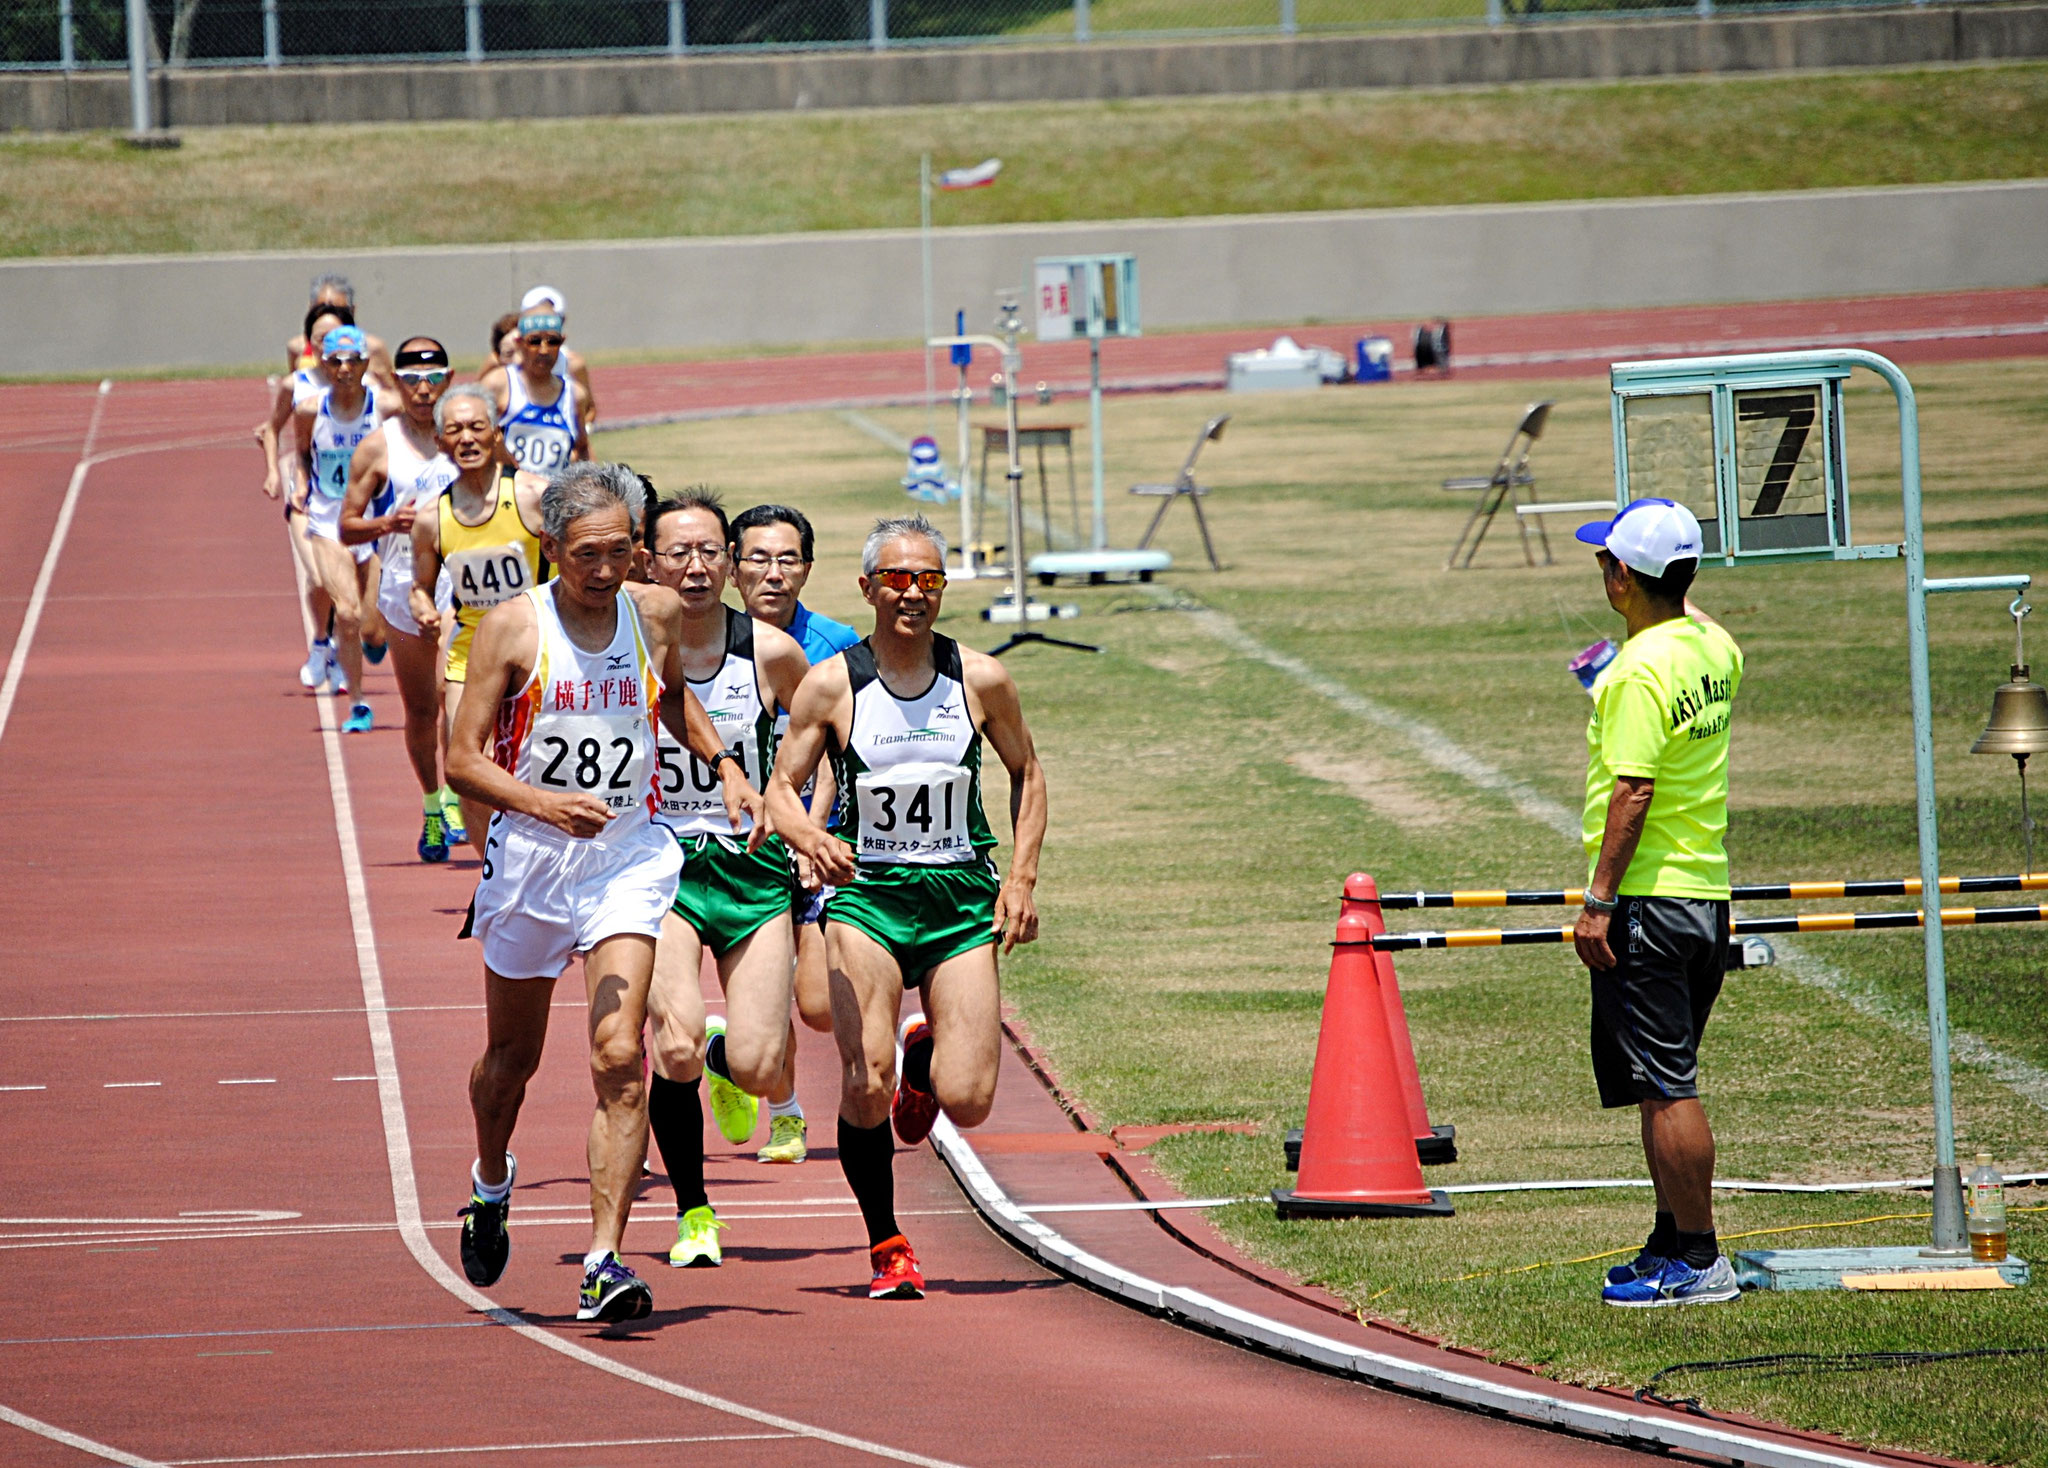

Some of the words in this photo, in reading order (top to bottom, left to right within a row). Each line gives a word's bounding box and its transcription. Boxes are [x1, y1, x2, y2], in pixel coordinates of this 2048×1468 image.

[514, 435, 562, 468] 809
[1738, 394, 1815, 515] 7
[461, 555, 524, 596] 440
[554, 675, 638, 712] 横手平鹿
[872, 734, 904, 746] Team
[541, 736, 635, 790] 282
[661, 799, 726, 811] 秋田マスター
[870, 782, 954, 833] 341
[863, 835, 965, 852] 秋田マスターズ陸上
